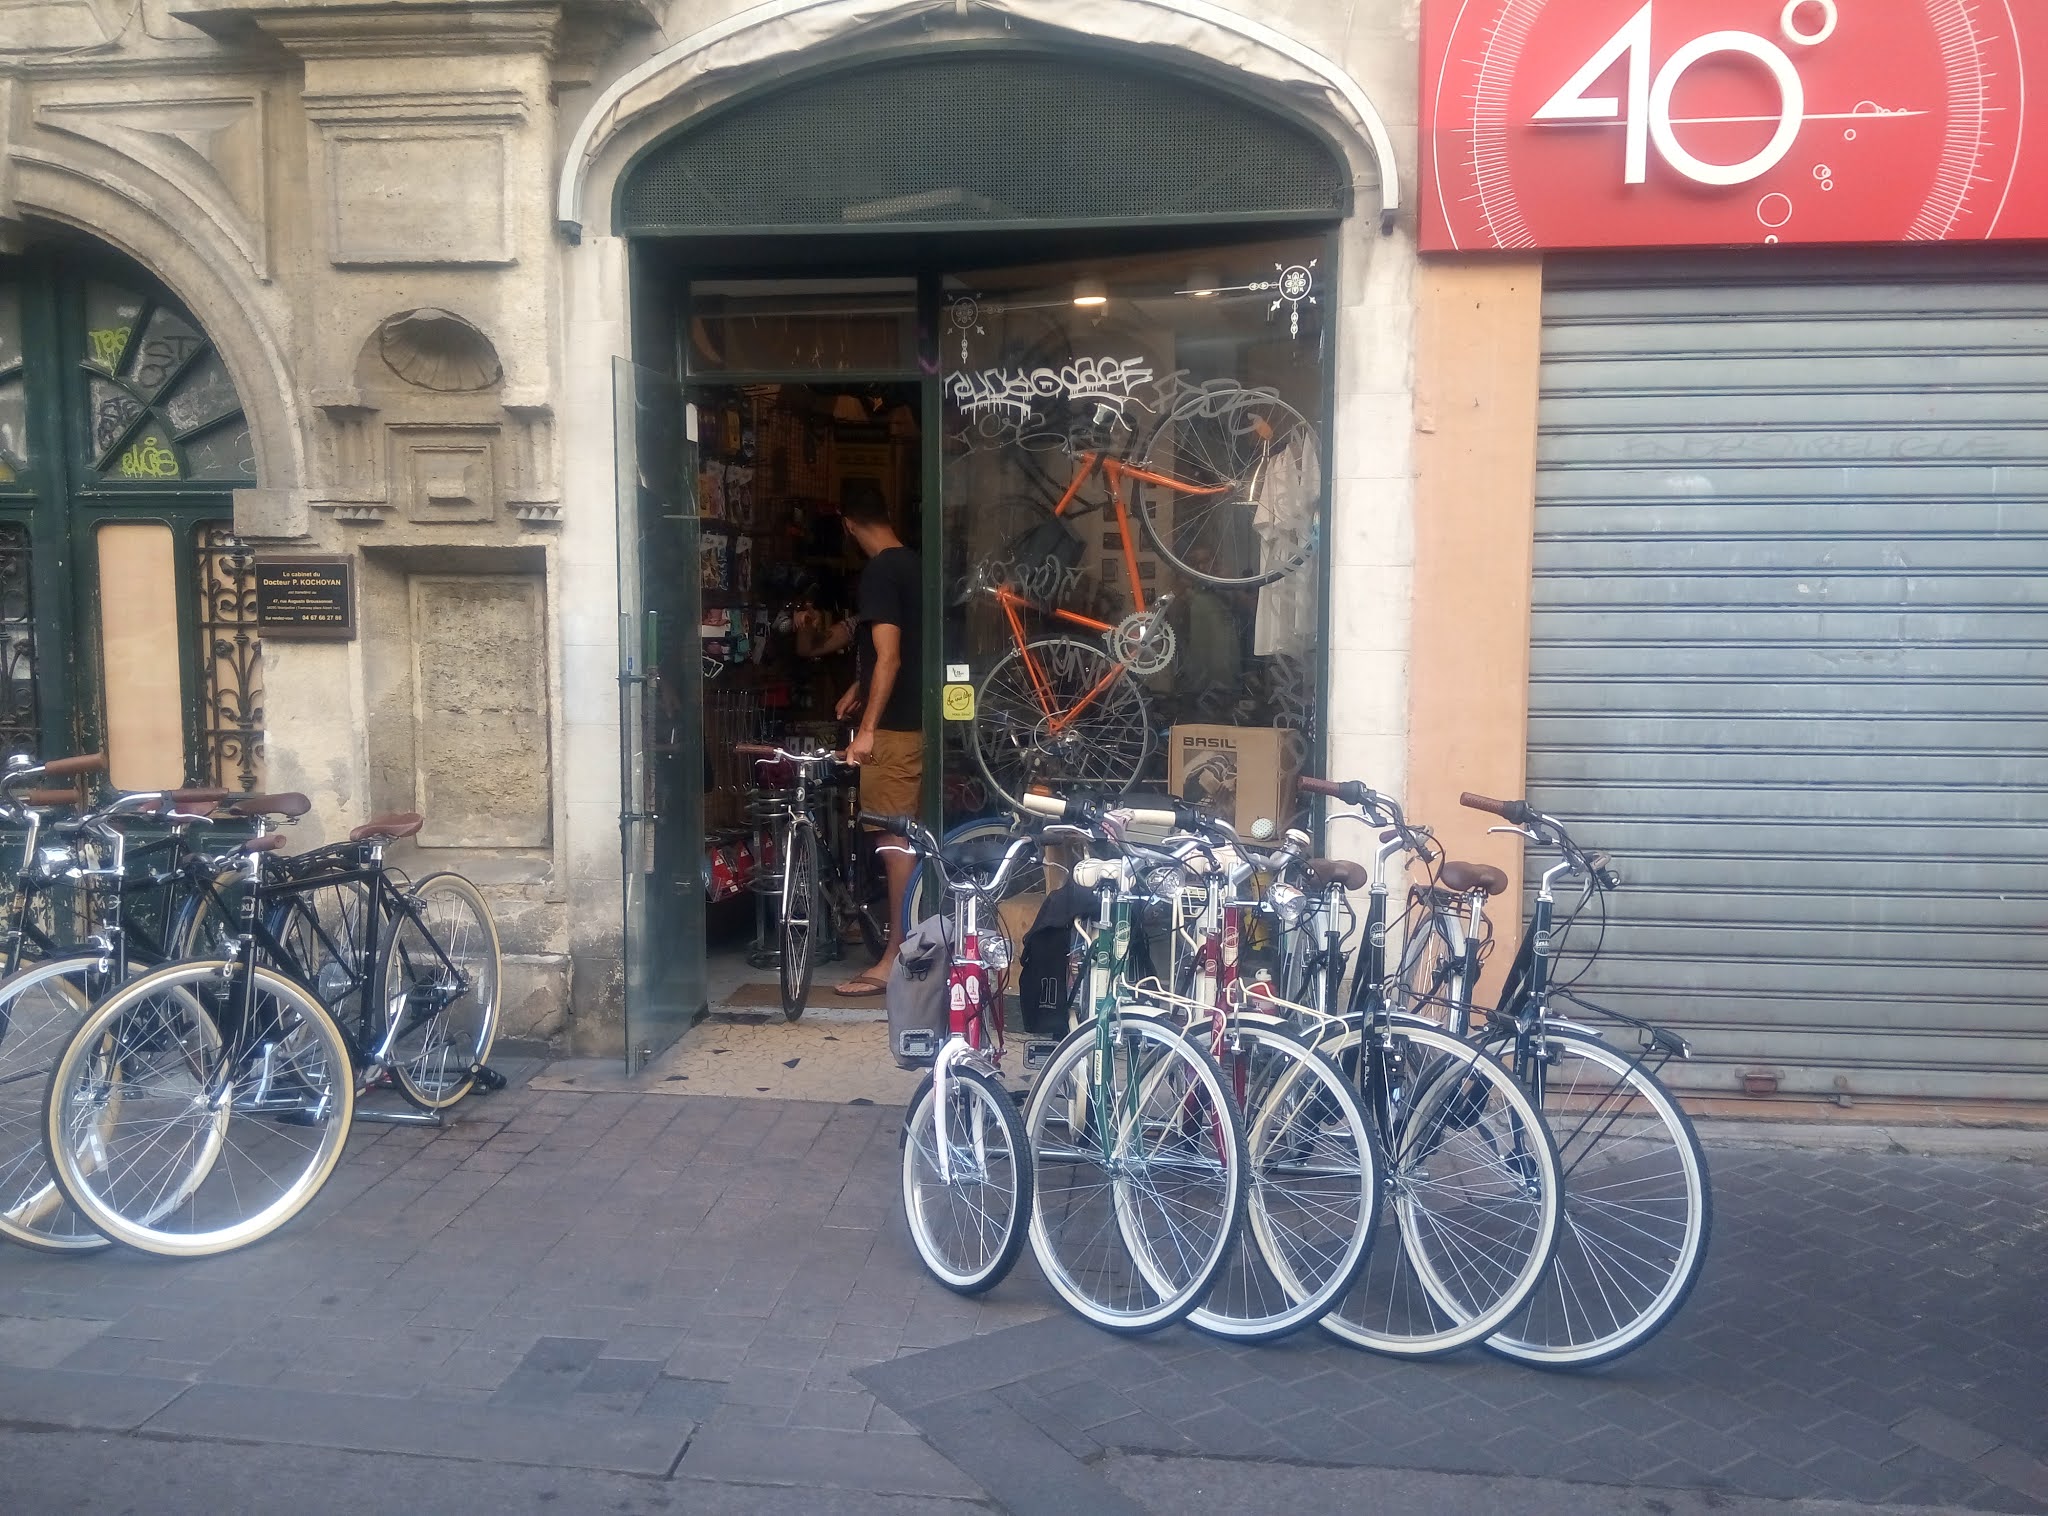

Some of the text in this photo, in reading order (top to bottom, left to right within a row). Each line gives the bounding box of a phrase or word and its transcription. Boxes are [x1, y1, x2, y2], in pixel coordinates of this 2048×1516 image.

[263, 578, 341, 586] Docteur P. KOCHOYAN
[1183, 736, 1237, 749] BASIL
